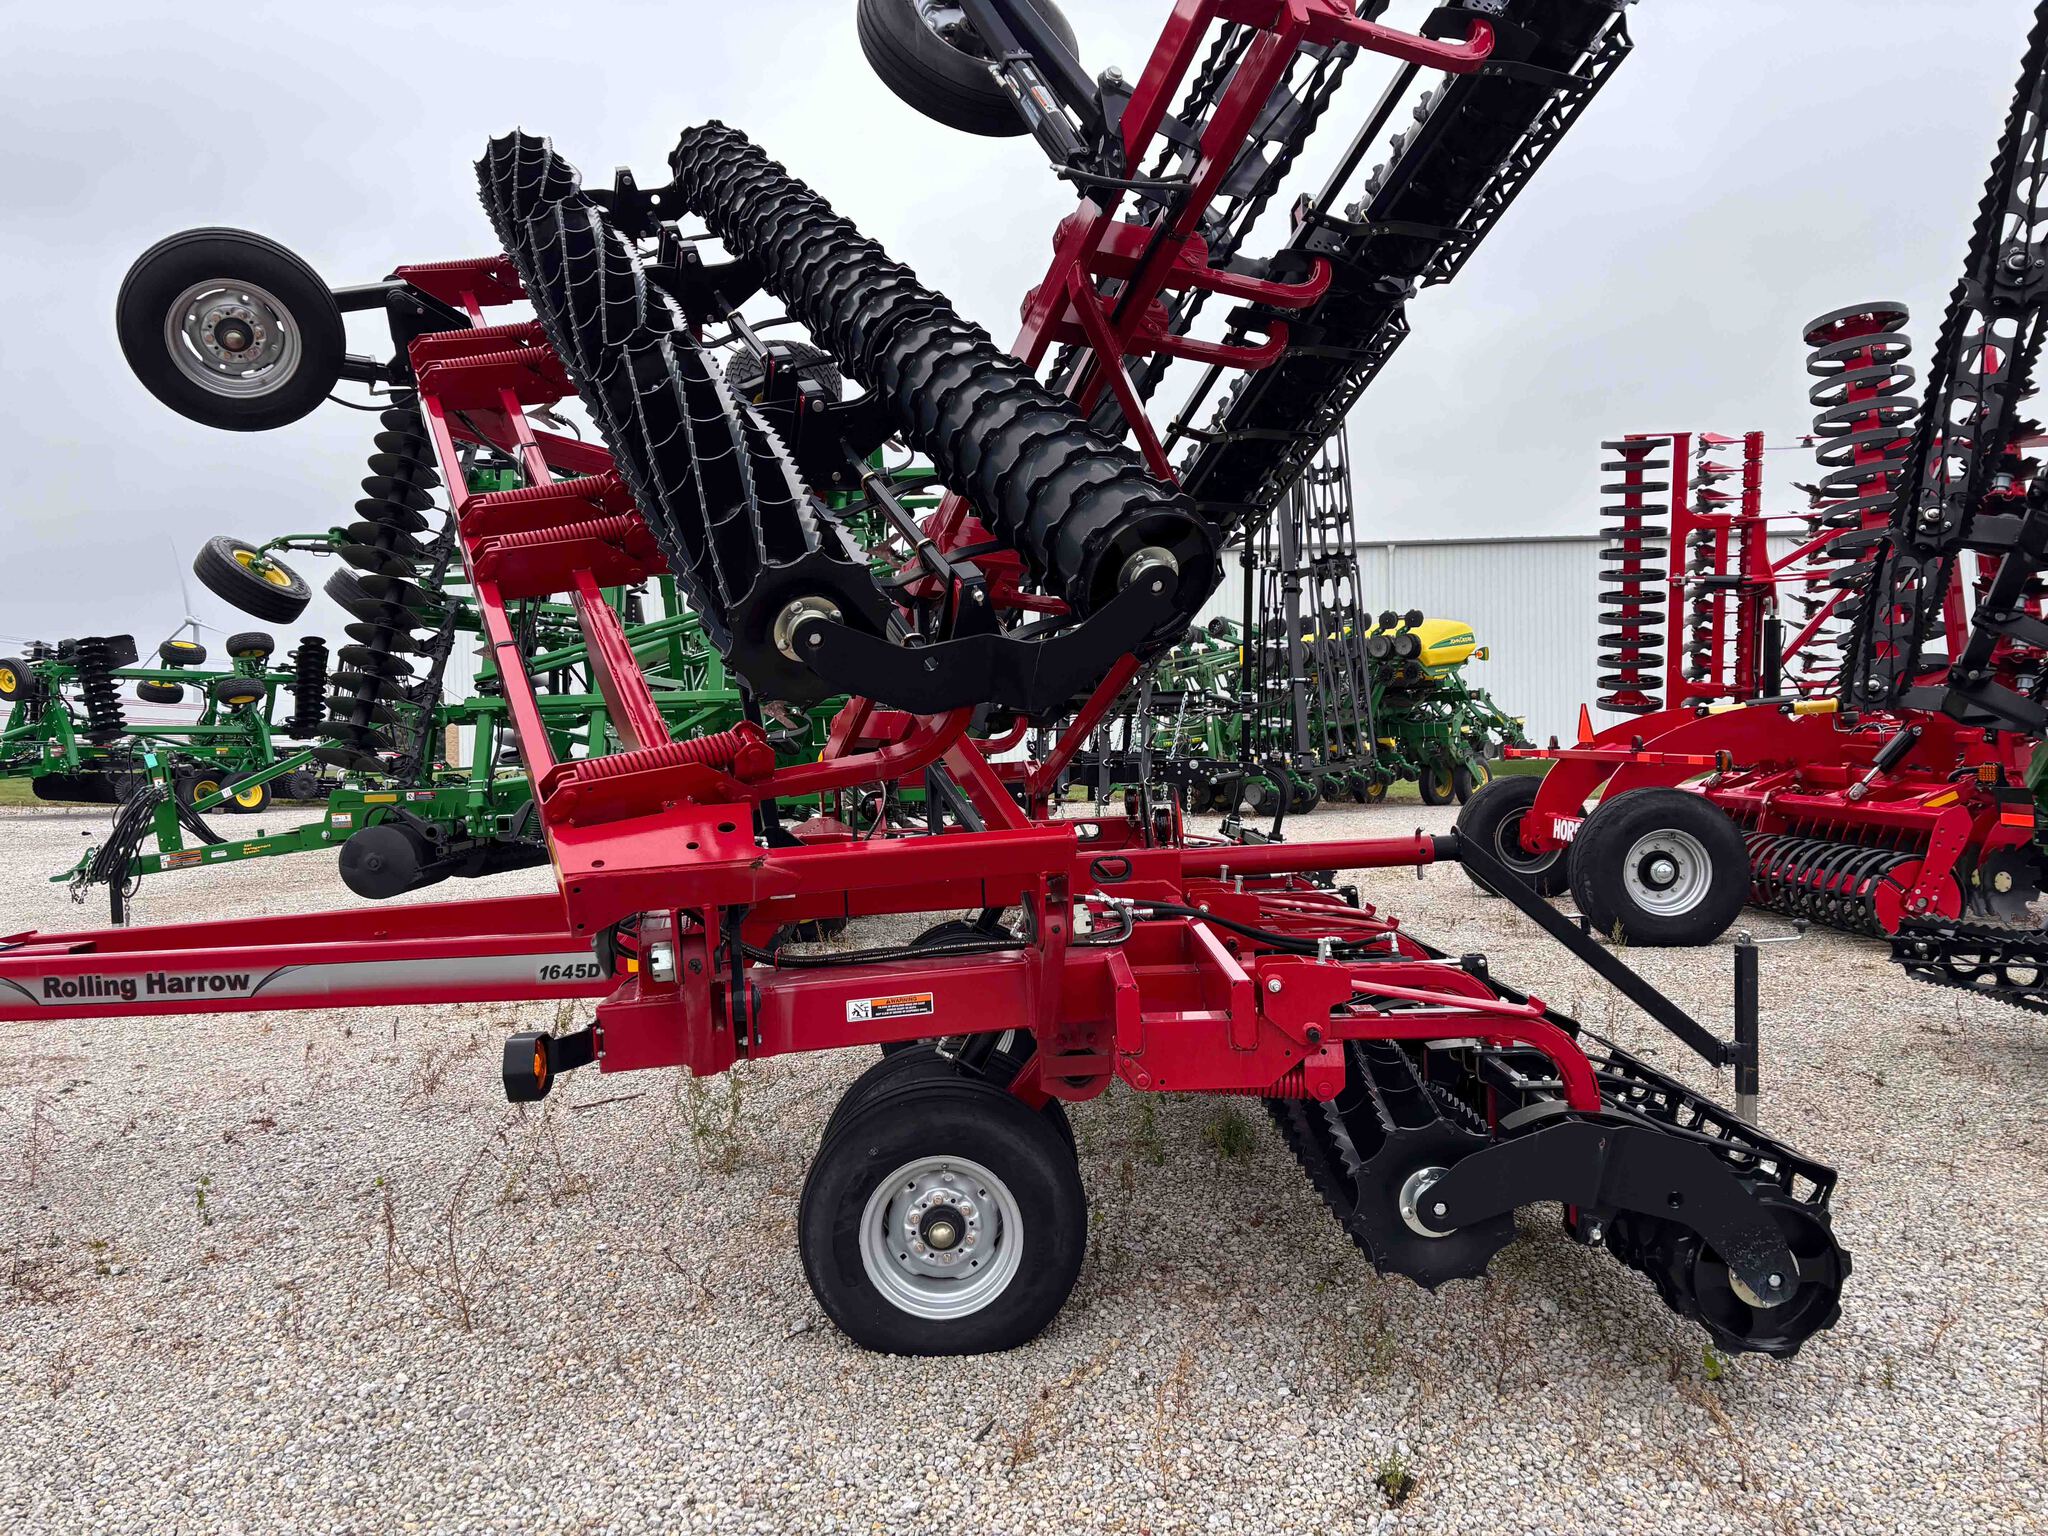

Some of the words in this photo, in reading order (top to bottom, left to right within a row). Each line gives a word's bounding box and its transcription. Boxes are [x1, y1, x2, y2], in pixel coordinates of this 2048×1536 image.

[540, 963, 600, 980] 1645D
[44, 975, 137, 1000] Rolling
[146, 972, 250, 994] Harrow
[890, 996, 917, 1004] WARNING
